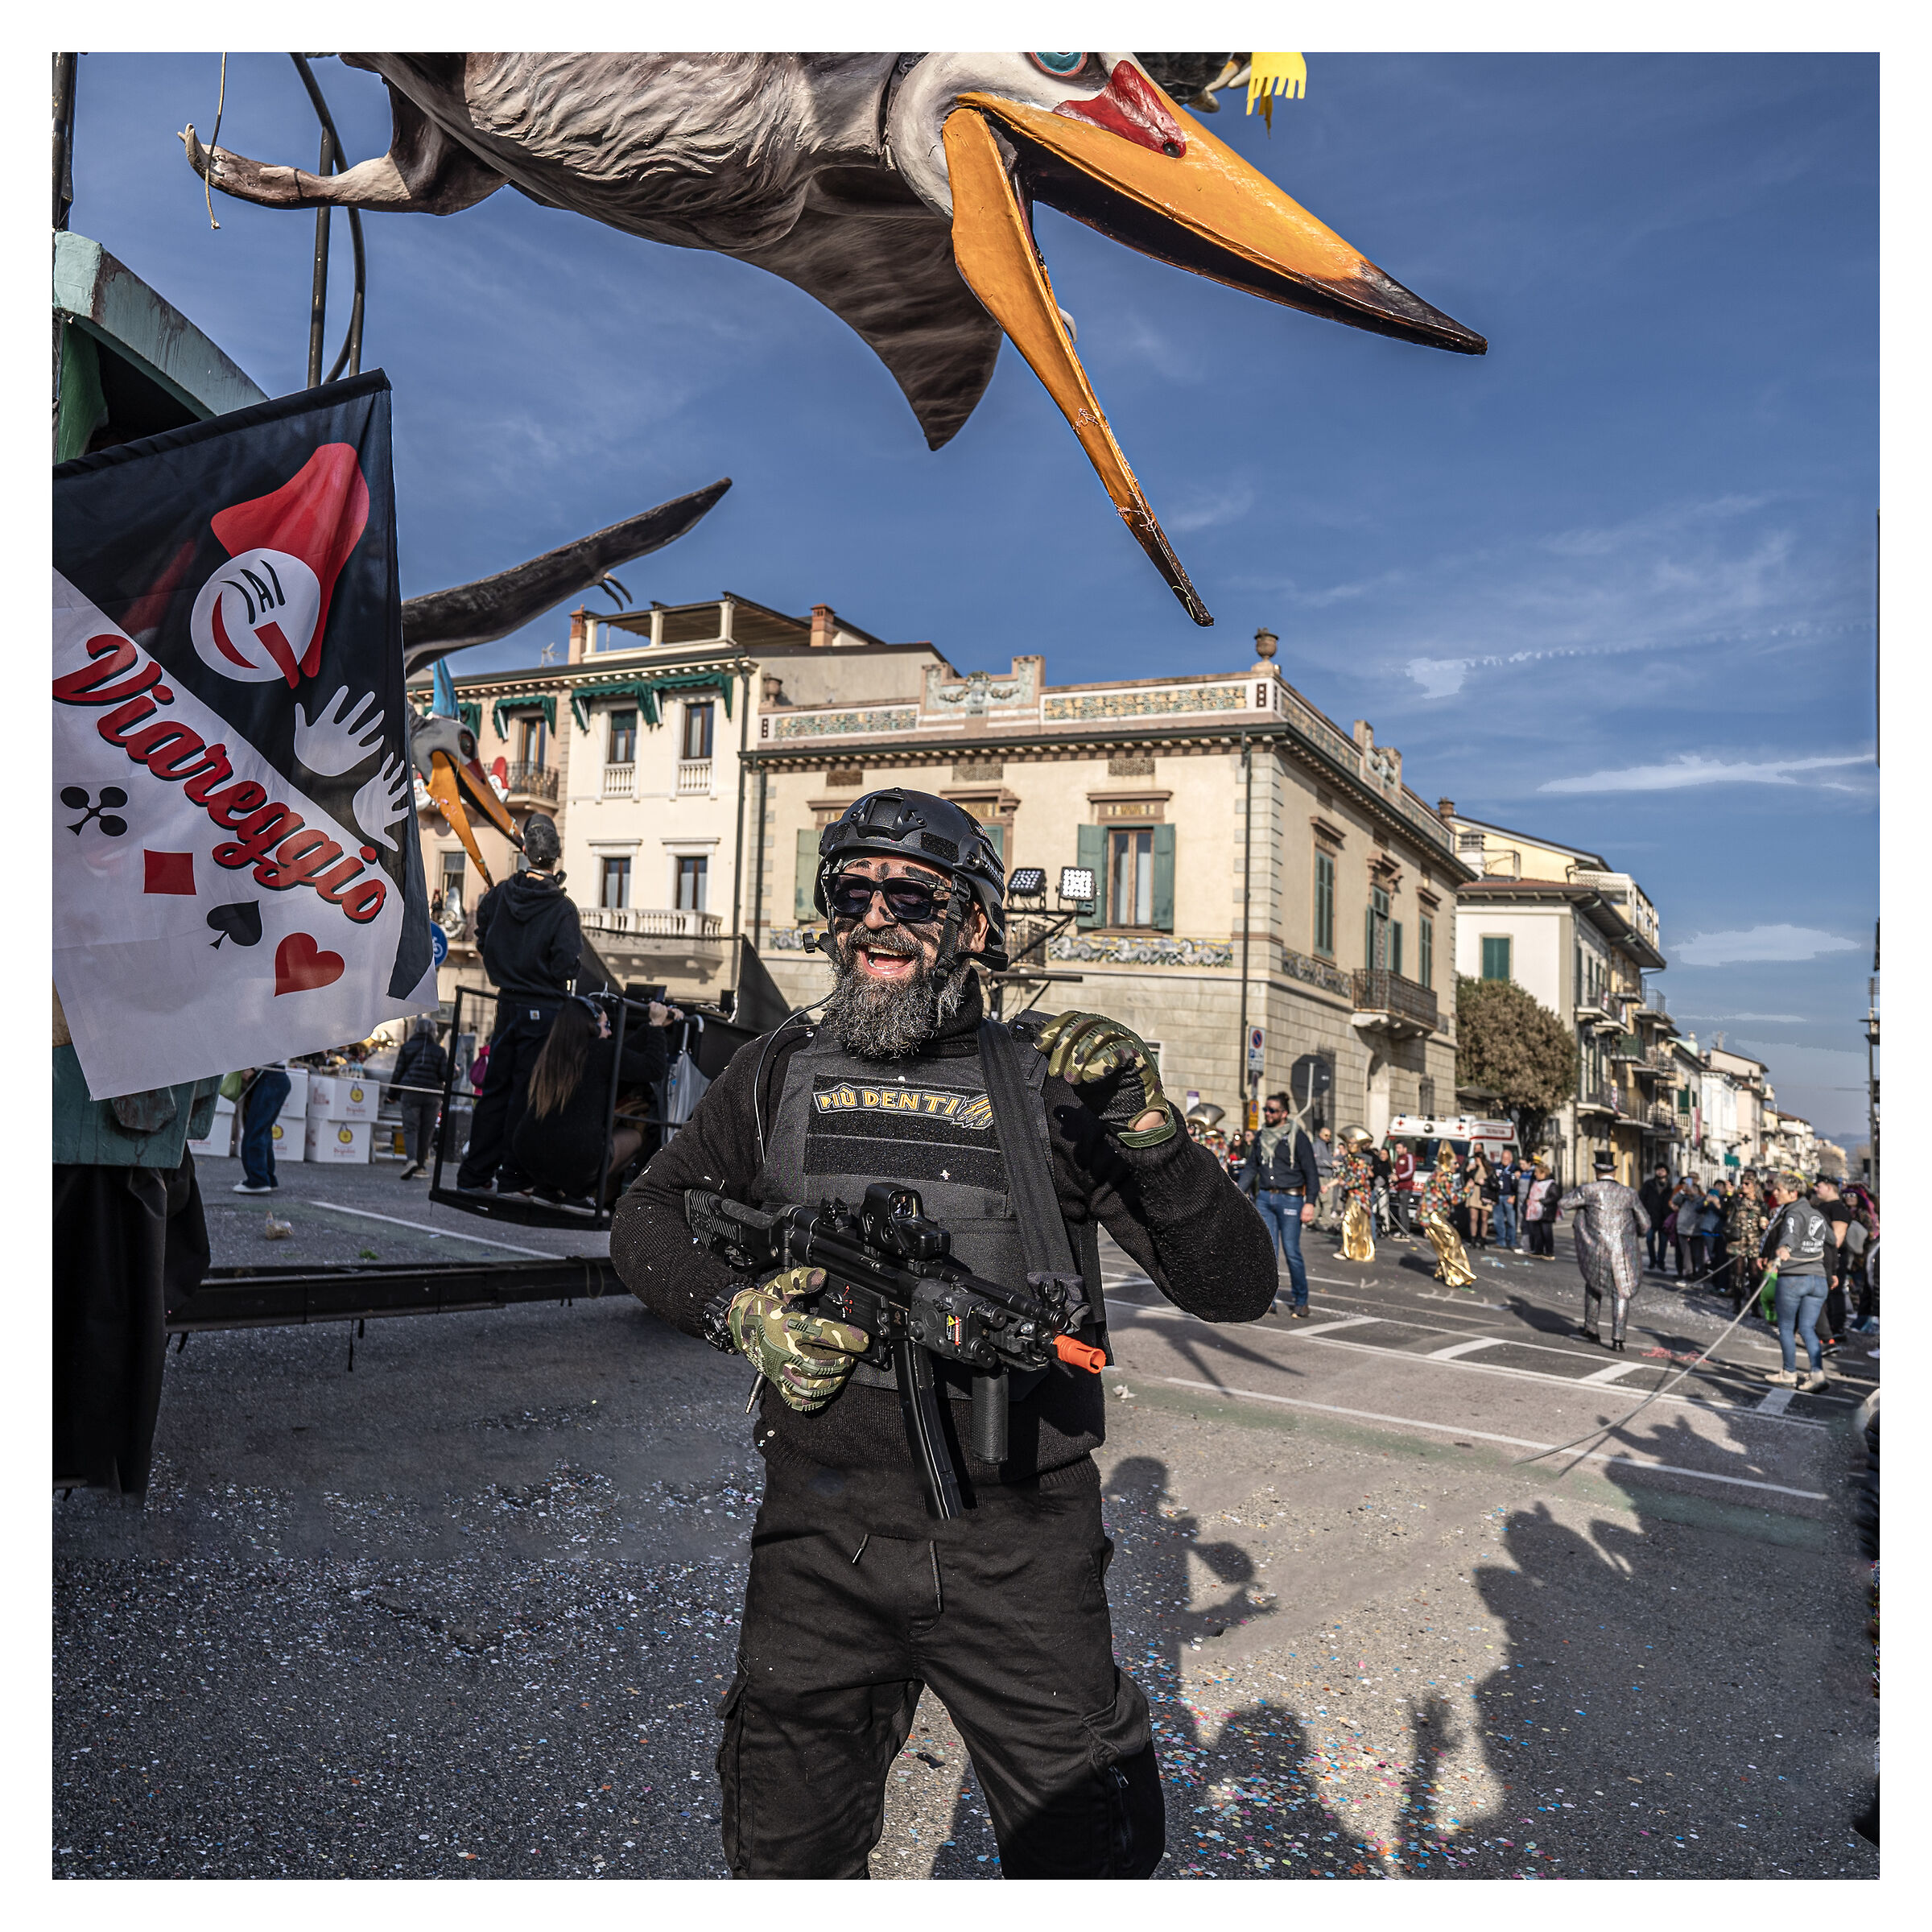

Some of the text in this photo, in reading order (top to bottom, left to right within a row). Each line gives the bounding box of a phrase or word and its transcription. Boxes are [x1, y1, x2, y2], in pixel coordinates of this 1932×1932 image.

[52, 634, 388, 924] Viareggio
[819, 1087, 960, 1116] PIÙ DENTI
